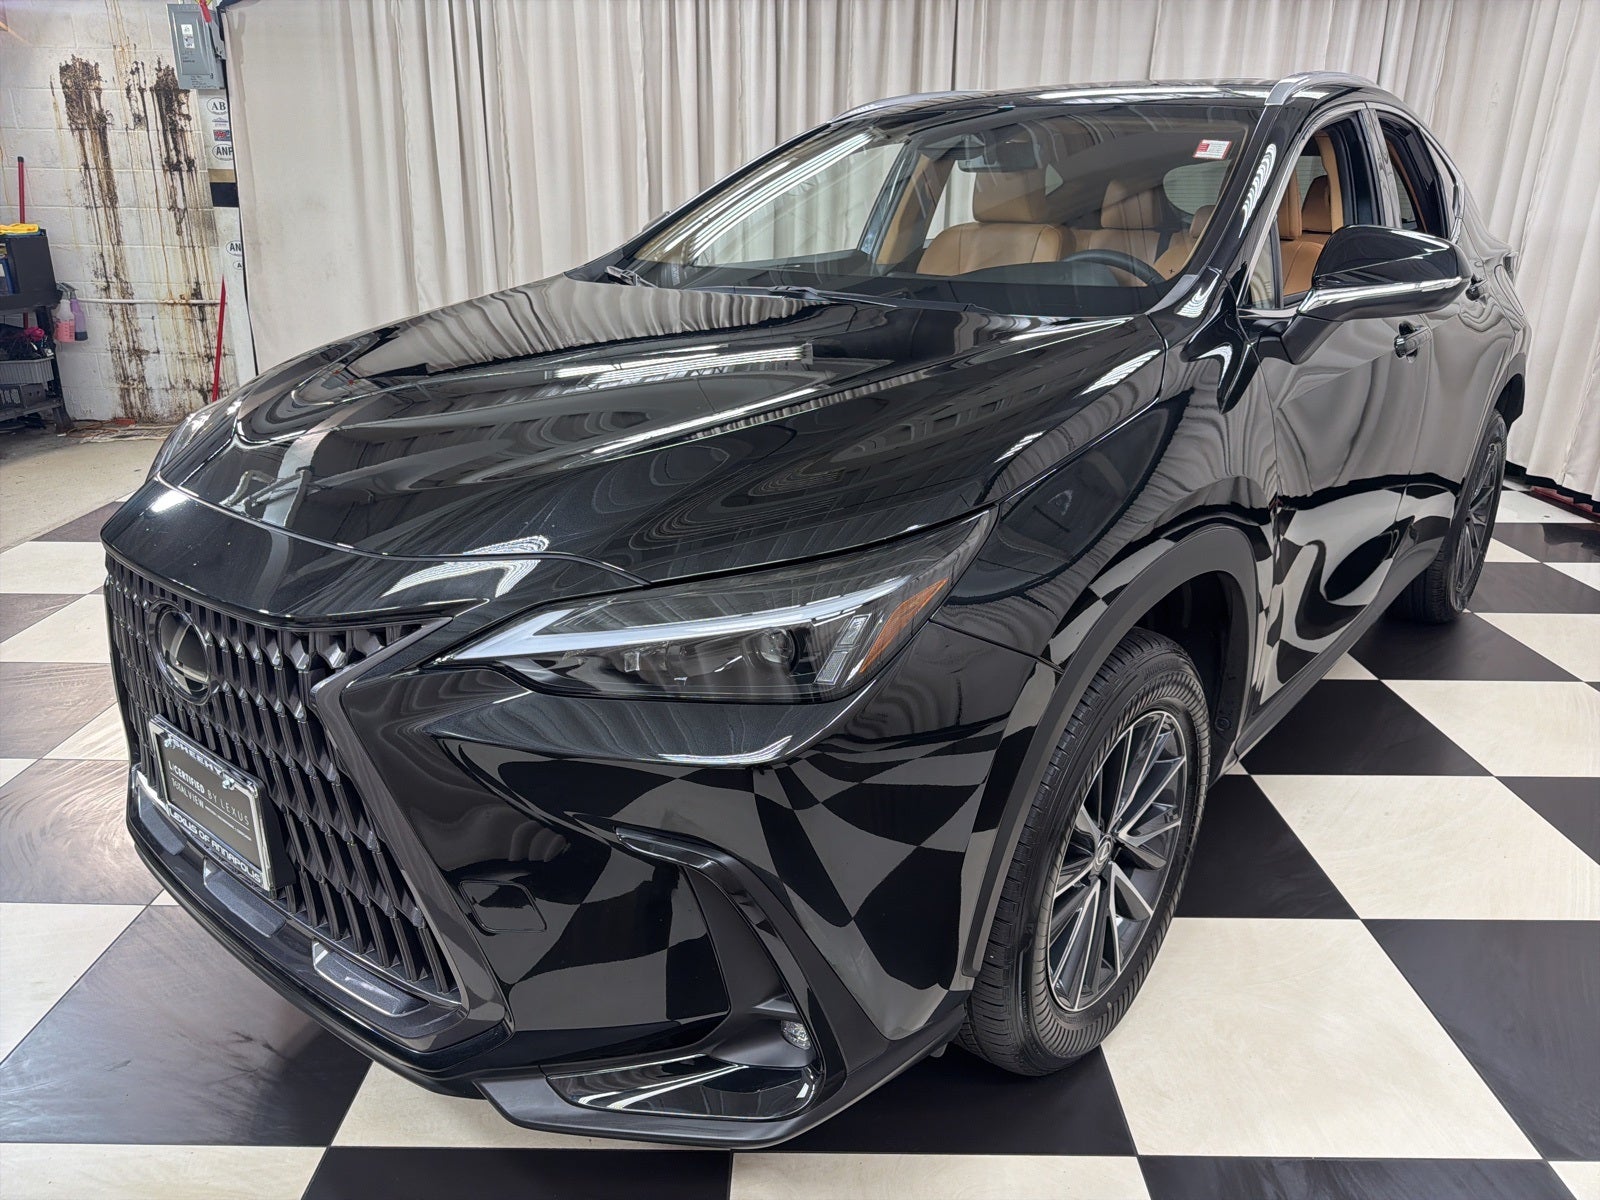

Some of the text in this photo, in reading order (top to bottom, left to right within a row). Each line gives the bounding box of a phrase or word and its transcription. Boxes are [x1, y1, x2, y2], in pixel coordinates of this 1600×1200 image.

[207, 789, 217, 803] BY
[220, 798, 250, 826] LEXUS
[170, 807, 198, 835] LEXUS
[198, 830, 211, 842] OF
[211, 839, 262, 884] ANNAPOLIS
